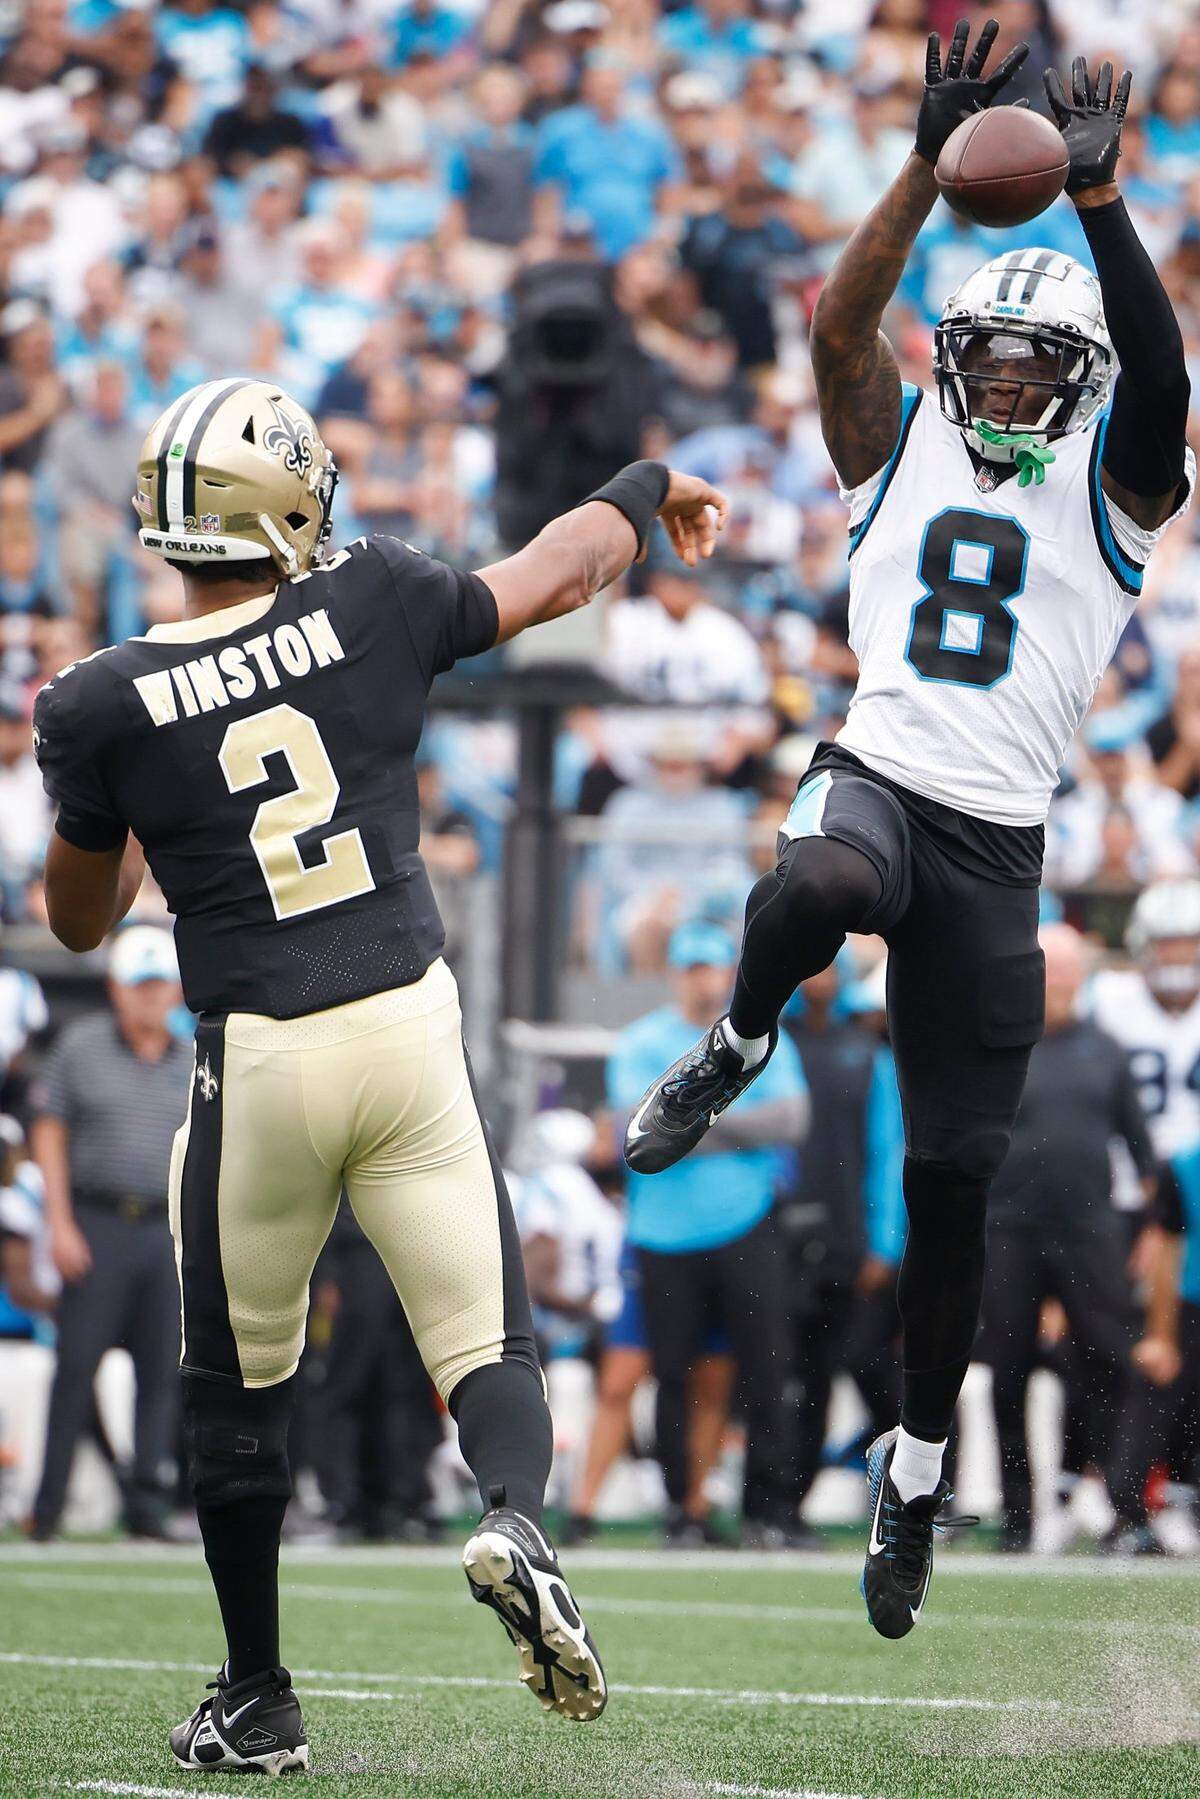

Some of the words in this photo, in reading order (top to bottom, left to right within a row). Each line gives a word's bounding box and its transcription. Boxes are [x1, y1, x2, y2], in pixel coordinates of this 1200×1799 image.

[165, 541, 226, 554] ORLEANS
[184, 515, 198, 534] 2
[903, 505, 1032, 691] 8
[132, 608, 345, 727] WINSTON
[217, 702, 376, 921] 2
